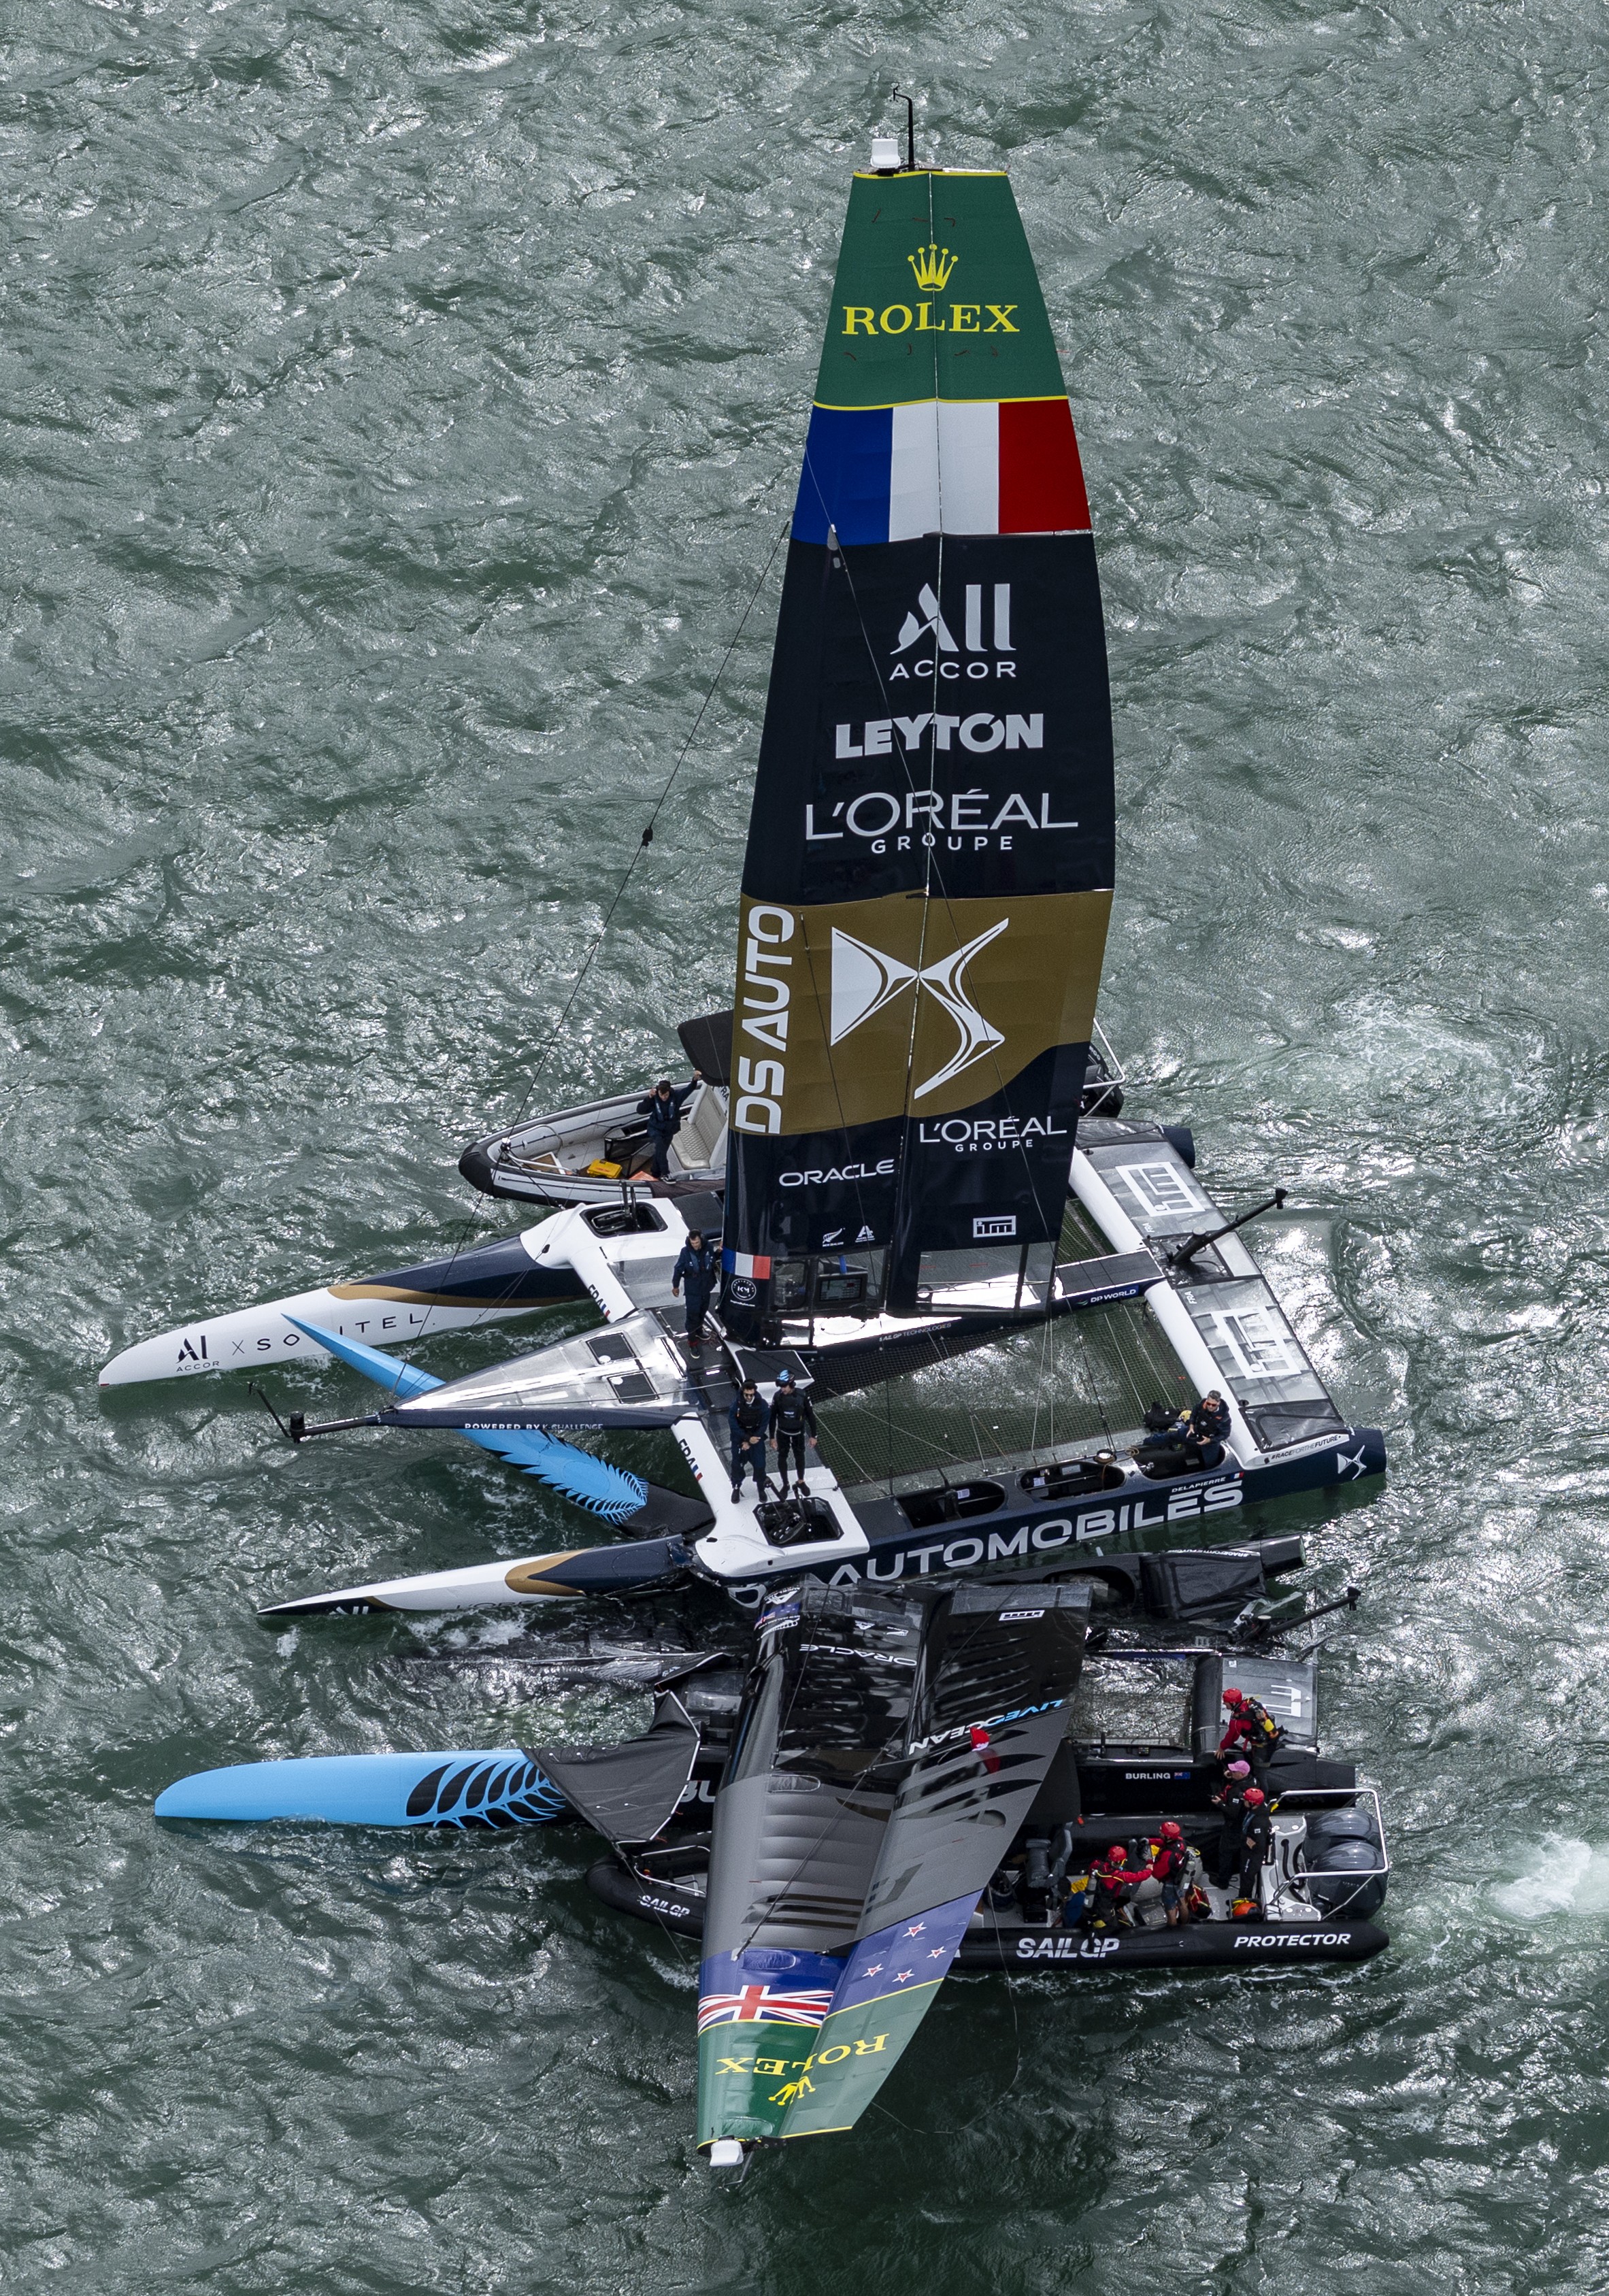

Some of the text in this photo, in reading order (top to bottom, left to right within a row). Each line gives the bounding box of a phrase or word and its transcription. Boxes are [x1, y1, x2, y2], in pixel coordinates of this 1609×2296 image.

[842, 302, 1020, 335] ROLEX
[889, 660, 1017, 681] ACCOR
[835, 712, 1044, 759] LEYTON
[870, 833, 1013, 854] GROUPE
[735, 905, 795, 1135] DS AUTO
[955, 1139, 1033, 1152] GROUPE
[778, 1158, 895, 1187] ORACLE
[1090, 1288, 1137, 1303] DP WORLD
[1184, 1291, 1197, 1305] FRA
[256, 1312, 423, 1351] SOITEL
[176, 1360, 220, 1373] ACCOR
[1271, 1435, 1339, 1460] #RACEFORTHEFUTURE
[1172, 1476, 1226, 1493] DELAPIERRE
[829, 1480, 1244, 1585] AUTOMOBILES
[799, 1643, 918, 1666] ORACLE
[1233, 1933, 1352, 1948] PROTECTOR
[715, 2033, 891, 2077] ROLEX
